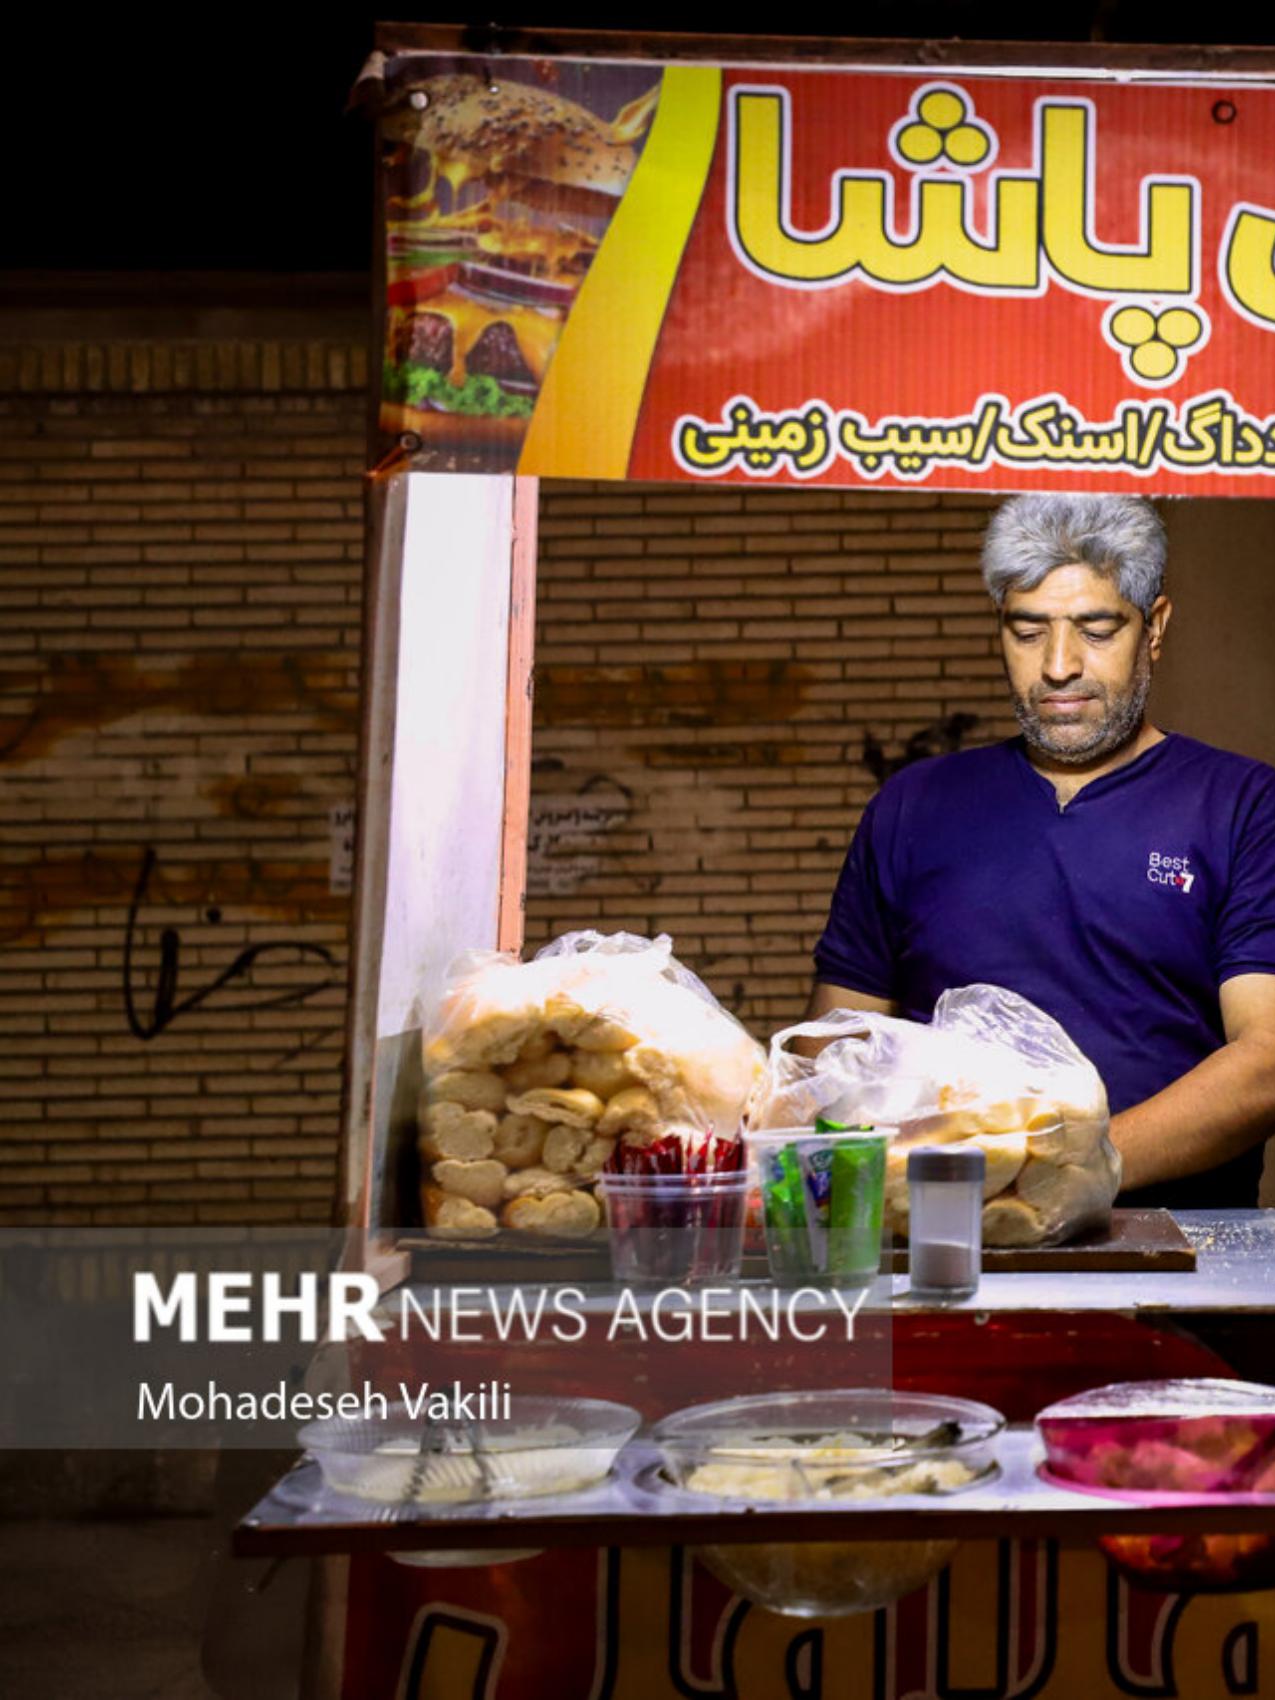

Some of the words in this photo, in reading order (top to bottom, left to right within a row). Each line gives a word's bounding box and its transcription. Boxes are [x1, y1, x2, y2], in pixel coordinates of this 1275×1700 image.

[729, 83, 1208, 386] پاشا
[675, 397, 833, 476] زمینی
[1149, 852, 1190, 873] Best
